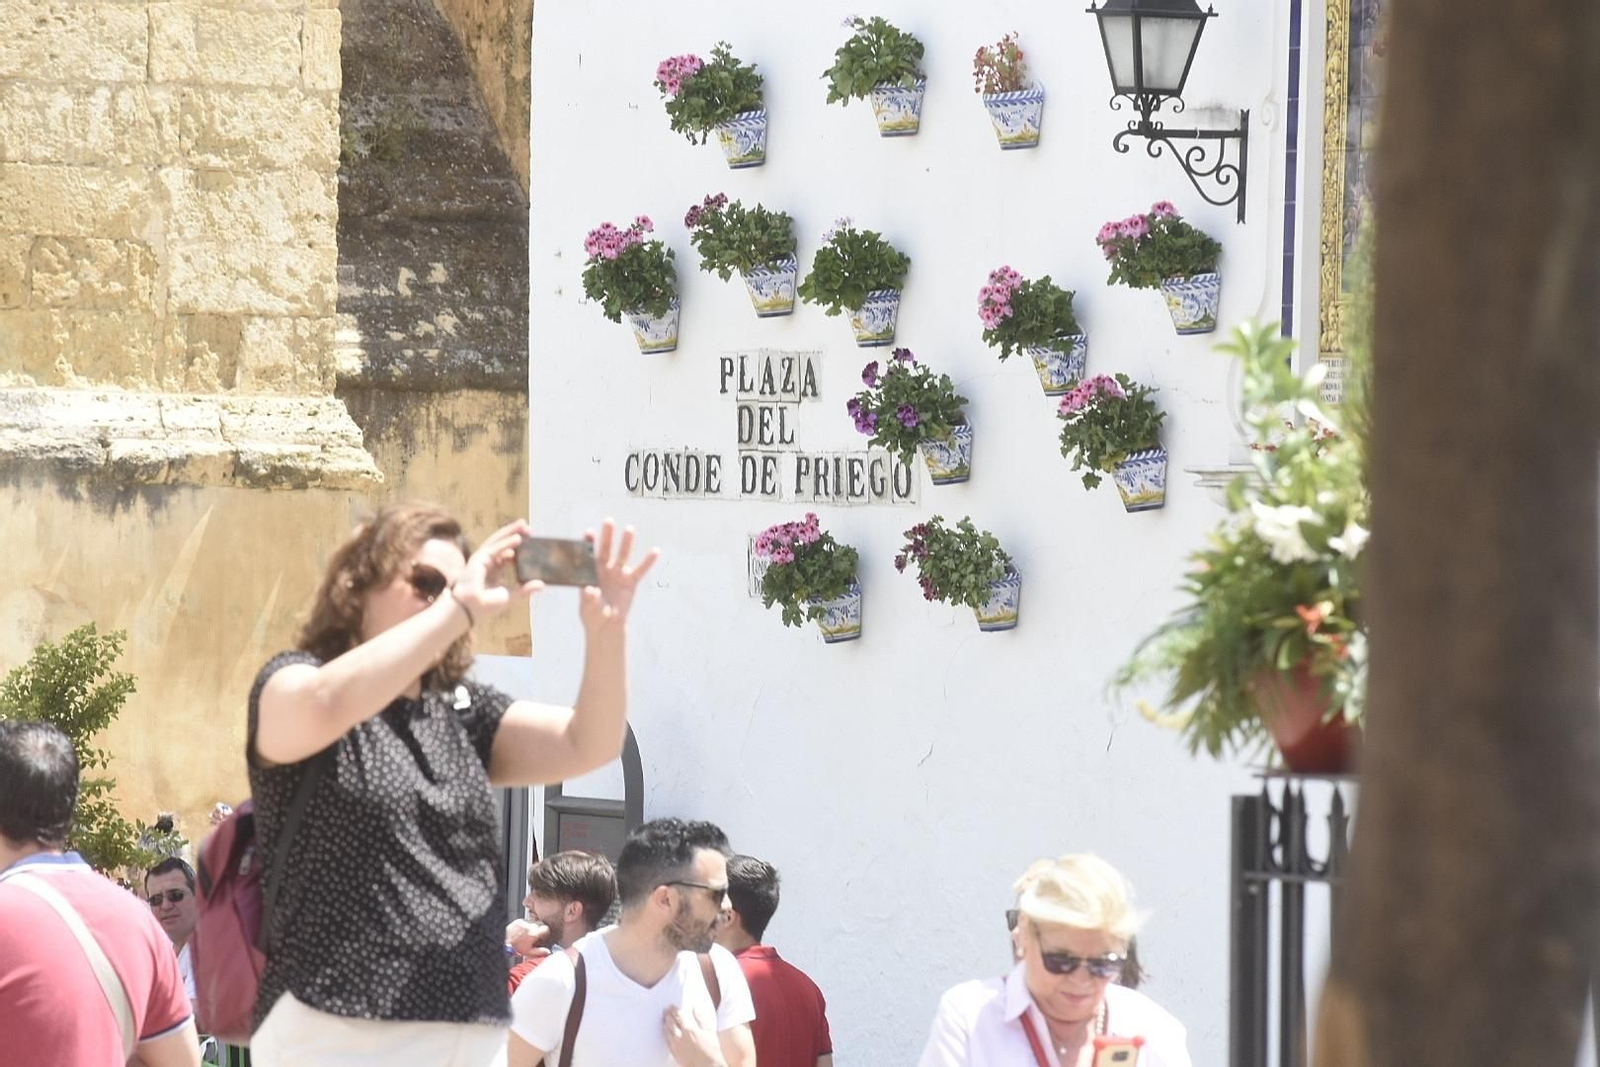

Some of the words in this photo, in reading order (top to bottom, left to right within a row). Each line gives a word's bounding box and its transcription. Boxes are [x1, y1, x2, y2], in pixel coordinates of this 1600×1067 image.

[719, 356, 819, 397] PLAZA
[737, 404, 795, 445] DEL
[624, 453, 722, 494] CONDE
[740, 455, 777, 495] DE
[794, 456, 912, 498] PRIEGO
